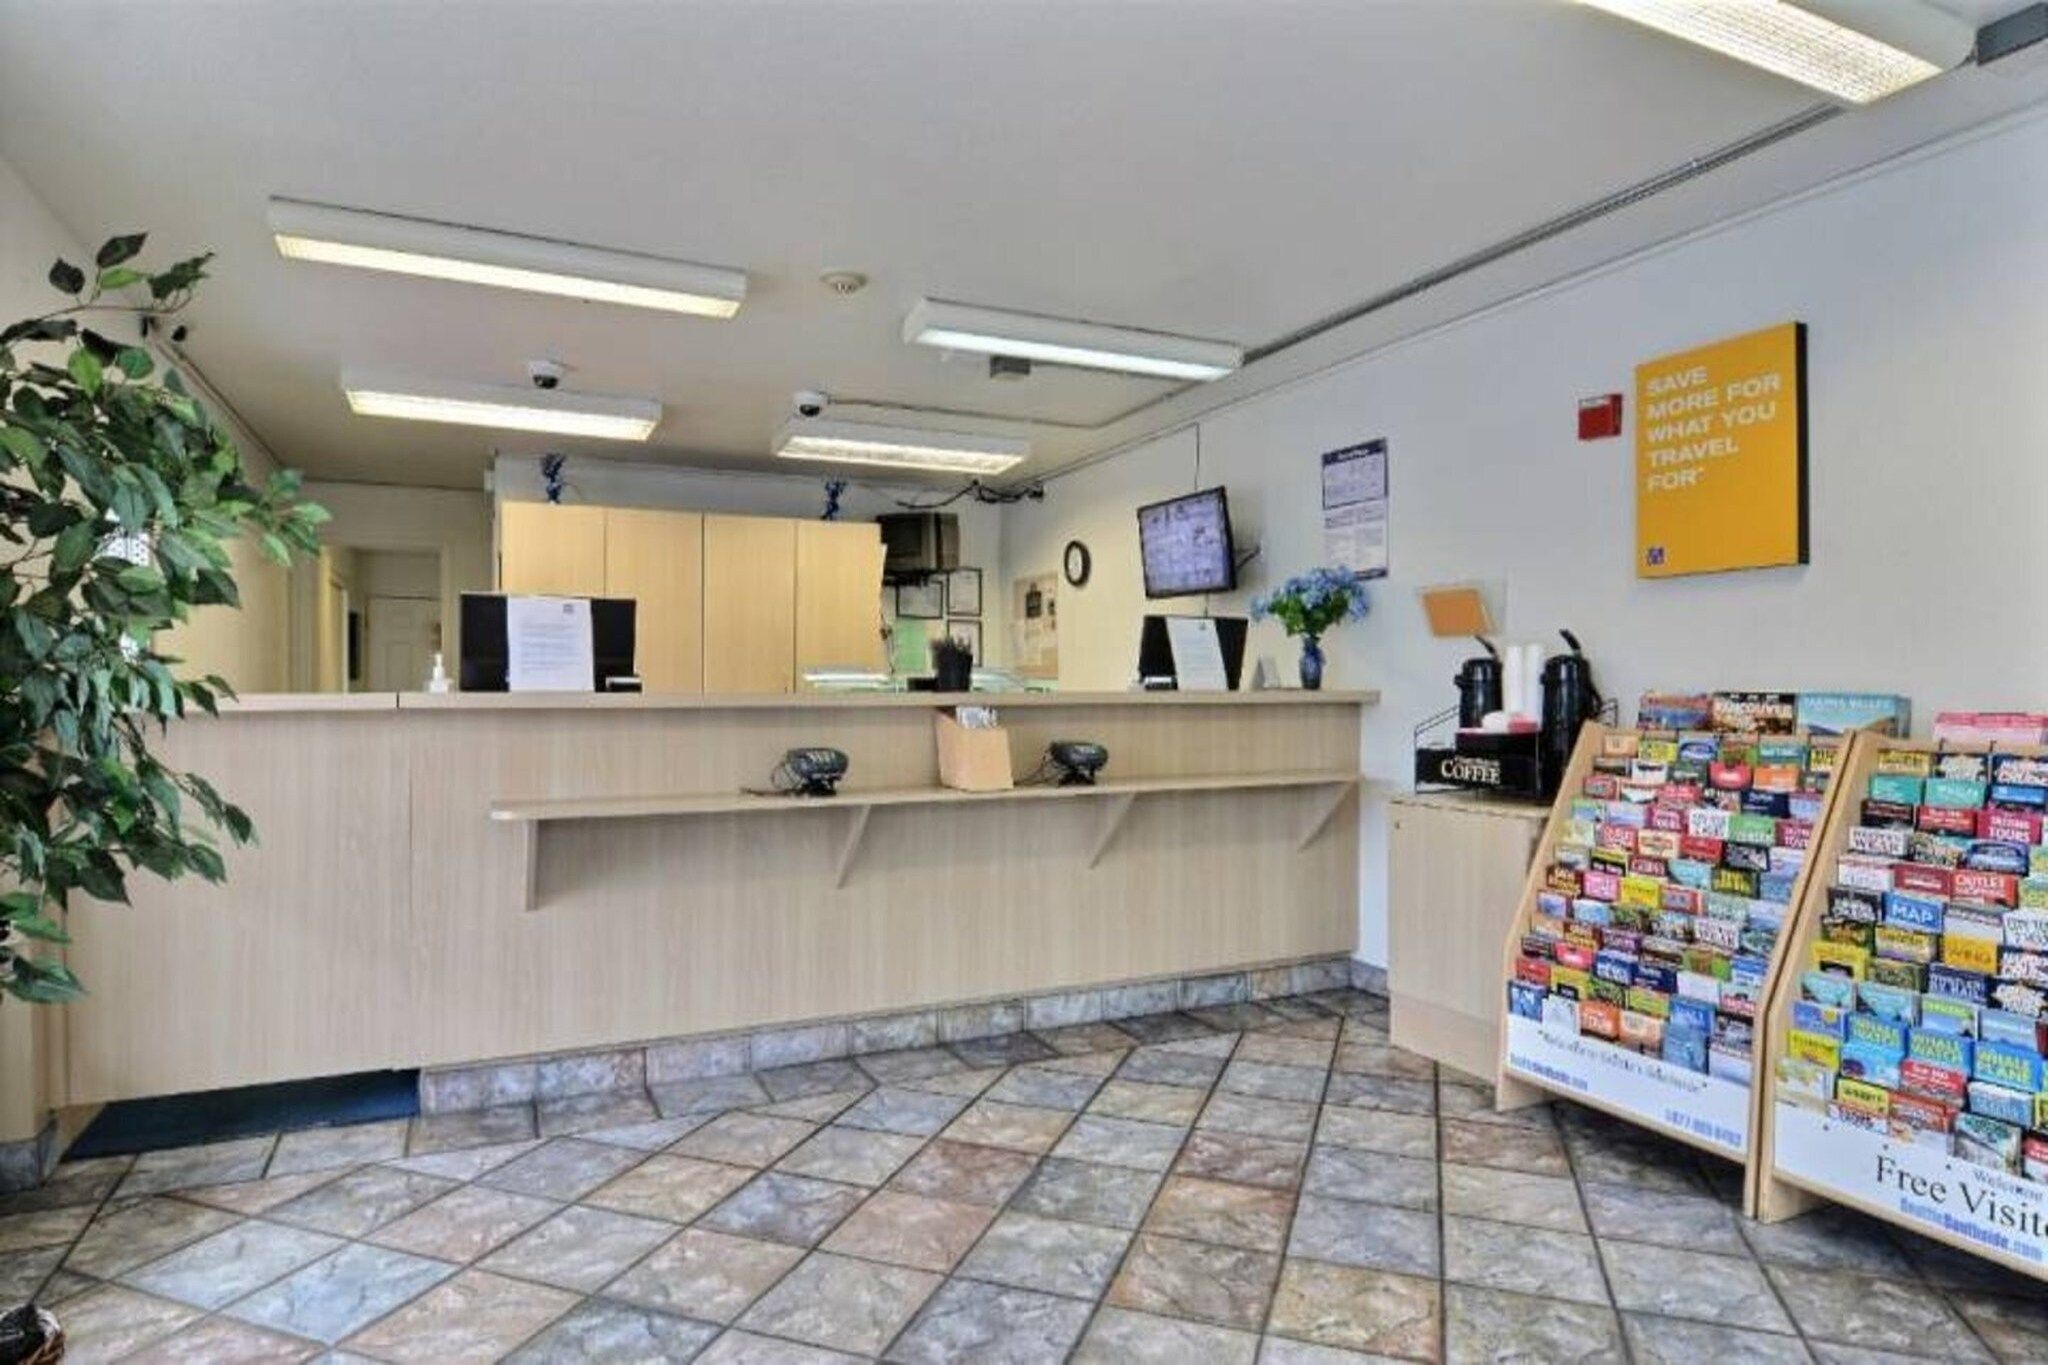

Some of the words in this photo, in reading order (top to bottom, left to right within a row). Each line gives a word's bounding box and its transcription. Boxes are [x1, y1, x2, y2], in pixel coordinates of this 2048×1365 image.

[1647, 366, 1707, 394] SAVE
[1647, 388, 1718, 420] MORE
[1727, 373, 1781, 402] FOR
[1647, 414, 1712, 443] WHAT
[1723, 401, 1777, 428] YOU
[1649, 437, 1740, 468] TRAVEL
[1441, 759, 1500, 784] COFFEE
[1892, 903, 1933, 923] MAP
[1876, 1155, 1947, 1203] Free
